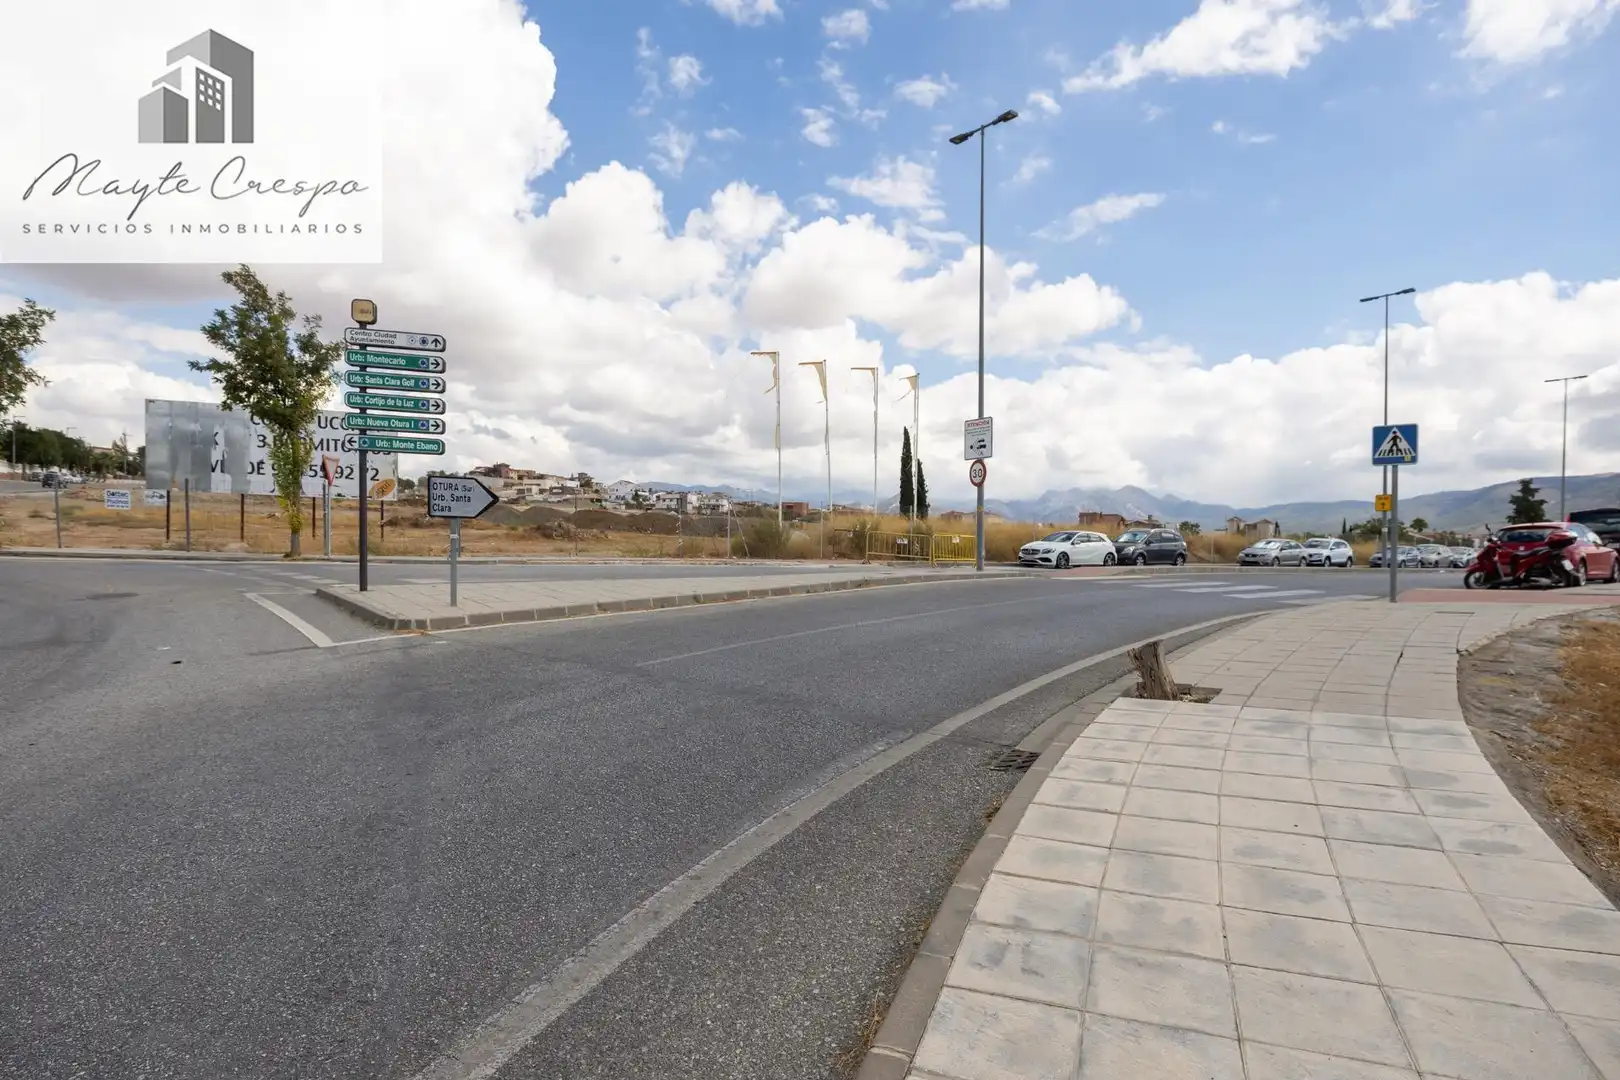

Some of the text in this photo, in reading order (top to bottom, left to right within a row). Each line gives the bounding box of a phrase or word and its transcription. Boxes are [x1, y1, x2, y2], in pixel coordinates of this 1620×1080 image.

[350, 329, 397, 339] Centro Ciudad
[350, 336, 395, 345] Ayuntamiento
[350, 353, 406, 365] Urb: Montecarlo
[350, 374, 415, 387] Urb: Santa Clara Golf
[350, 395, 415, 407] Urb: Cortijo de la Luz
[350, 415, 365, 425] Urb:
[366, 417, 388, 427] Nueva
[390, 418, 410, 428] Otura
[375, 438, 391, 448] Urb:
[392, 439, 415, 450] Monte
[416, 440, 439, 451] Ebano
[972, 468, 983, 479] 30
[432, 482, 459, 492] OTURA
[432, 493, 471, 503] Urb. Santa
[432, 503, 452, 513] Clara
